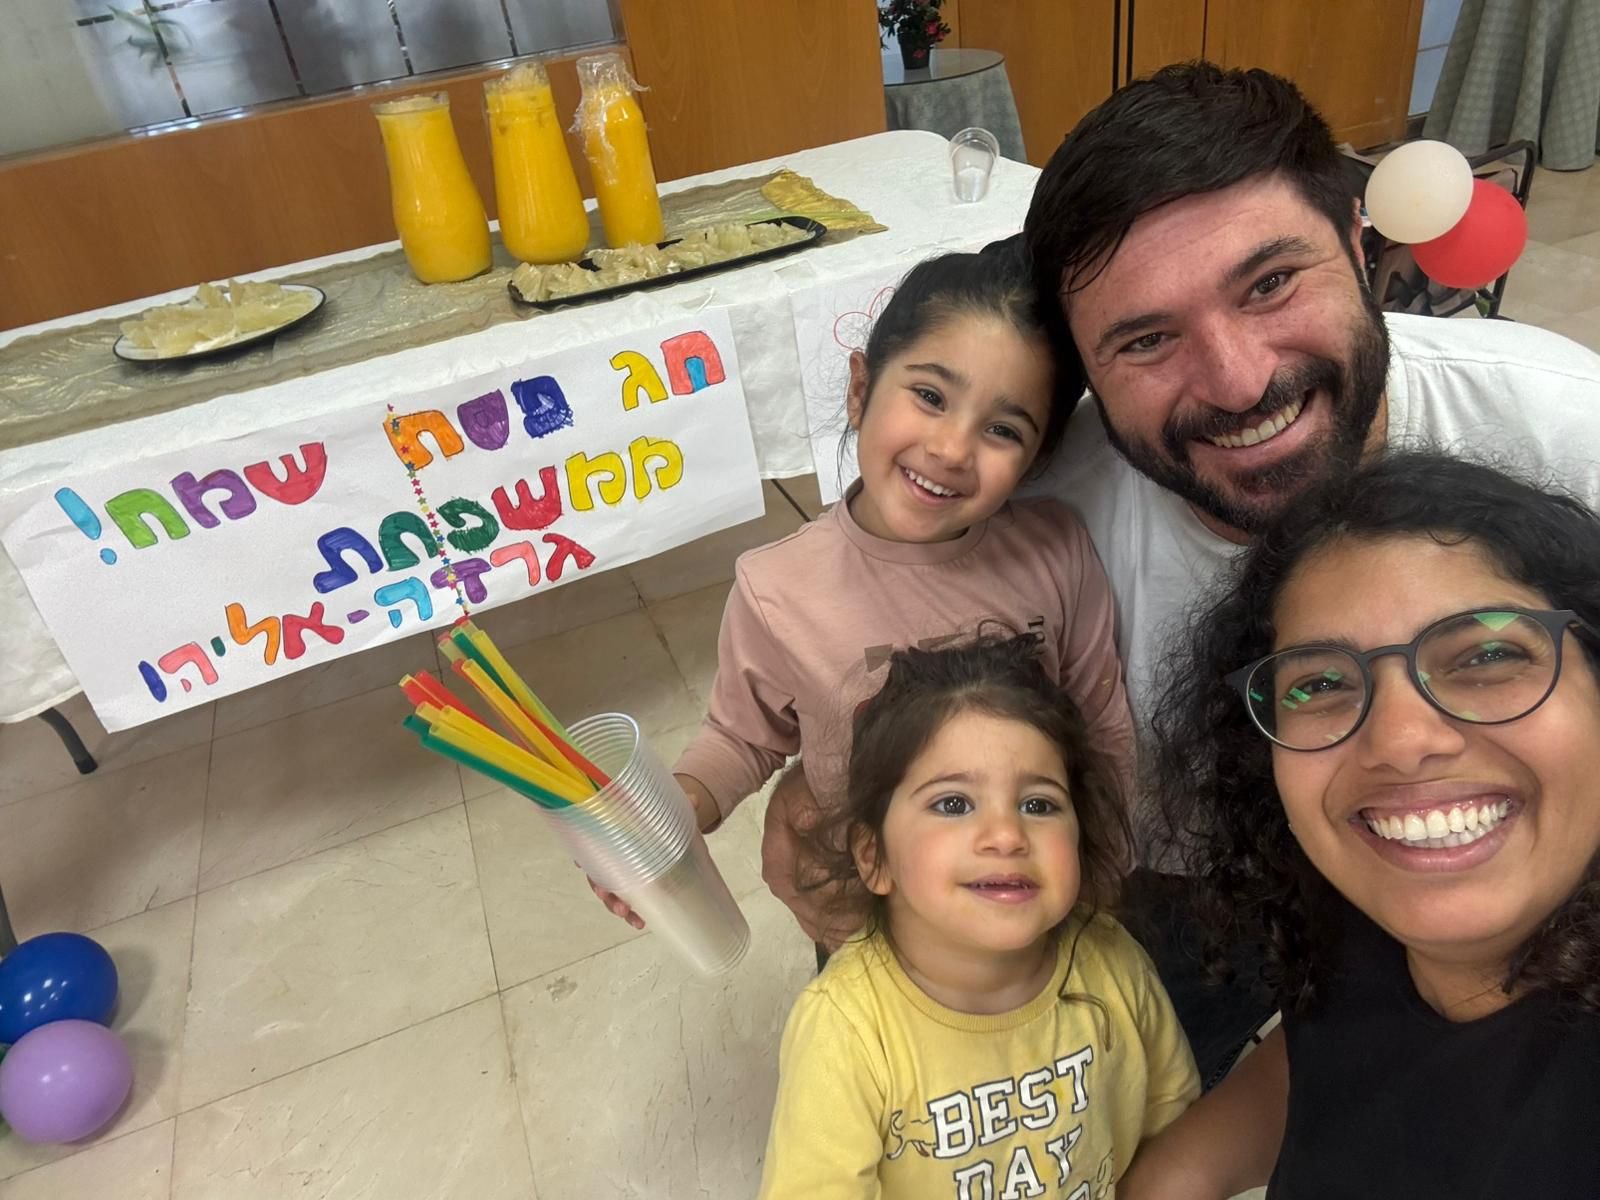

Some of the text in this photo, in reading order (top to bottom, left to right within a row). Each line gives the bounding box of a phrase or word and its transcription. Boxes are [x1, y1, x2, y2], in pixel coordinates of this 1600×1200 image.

[54, 330, 726, 566] חג פסח שמח!
[313, 436, 685, 593] ממשפחת
[928, 1044, 1093, 1159] BEST
[953, 1124, 1083, 1200] DAY
